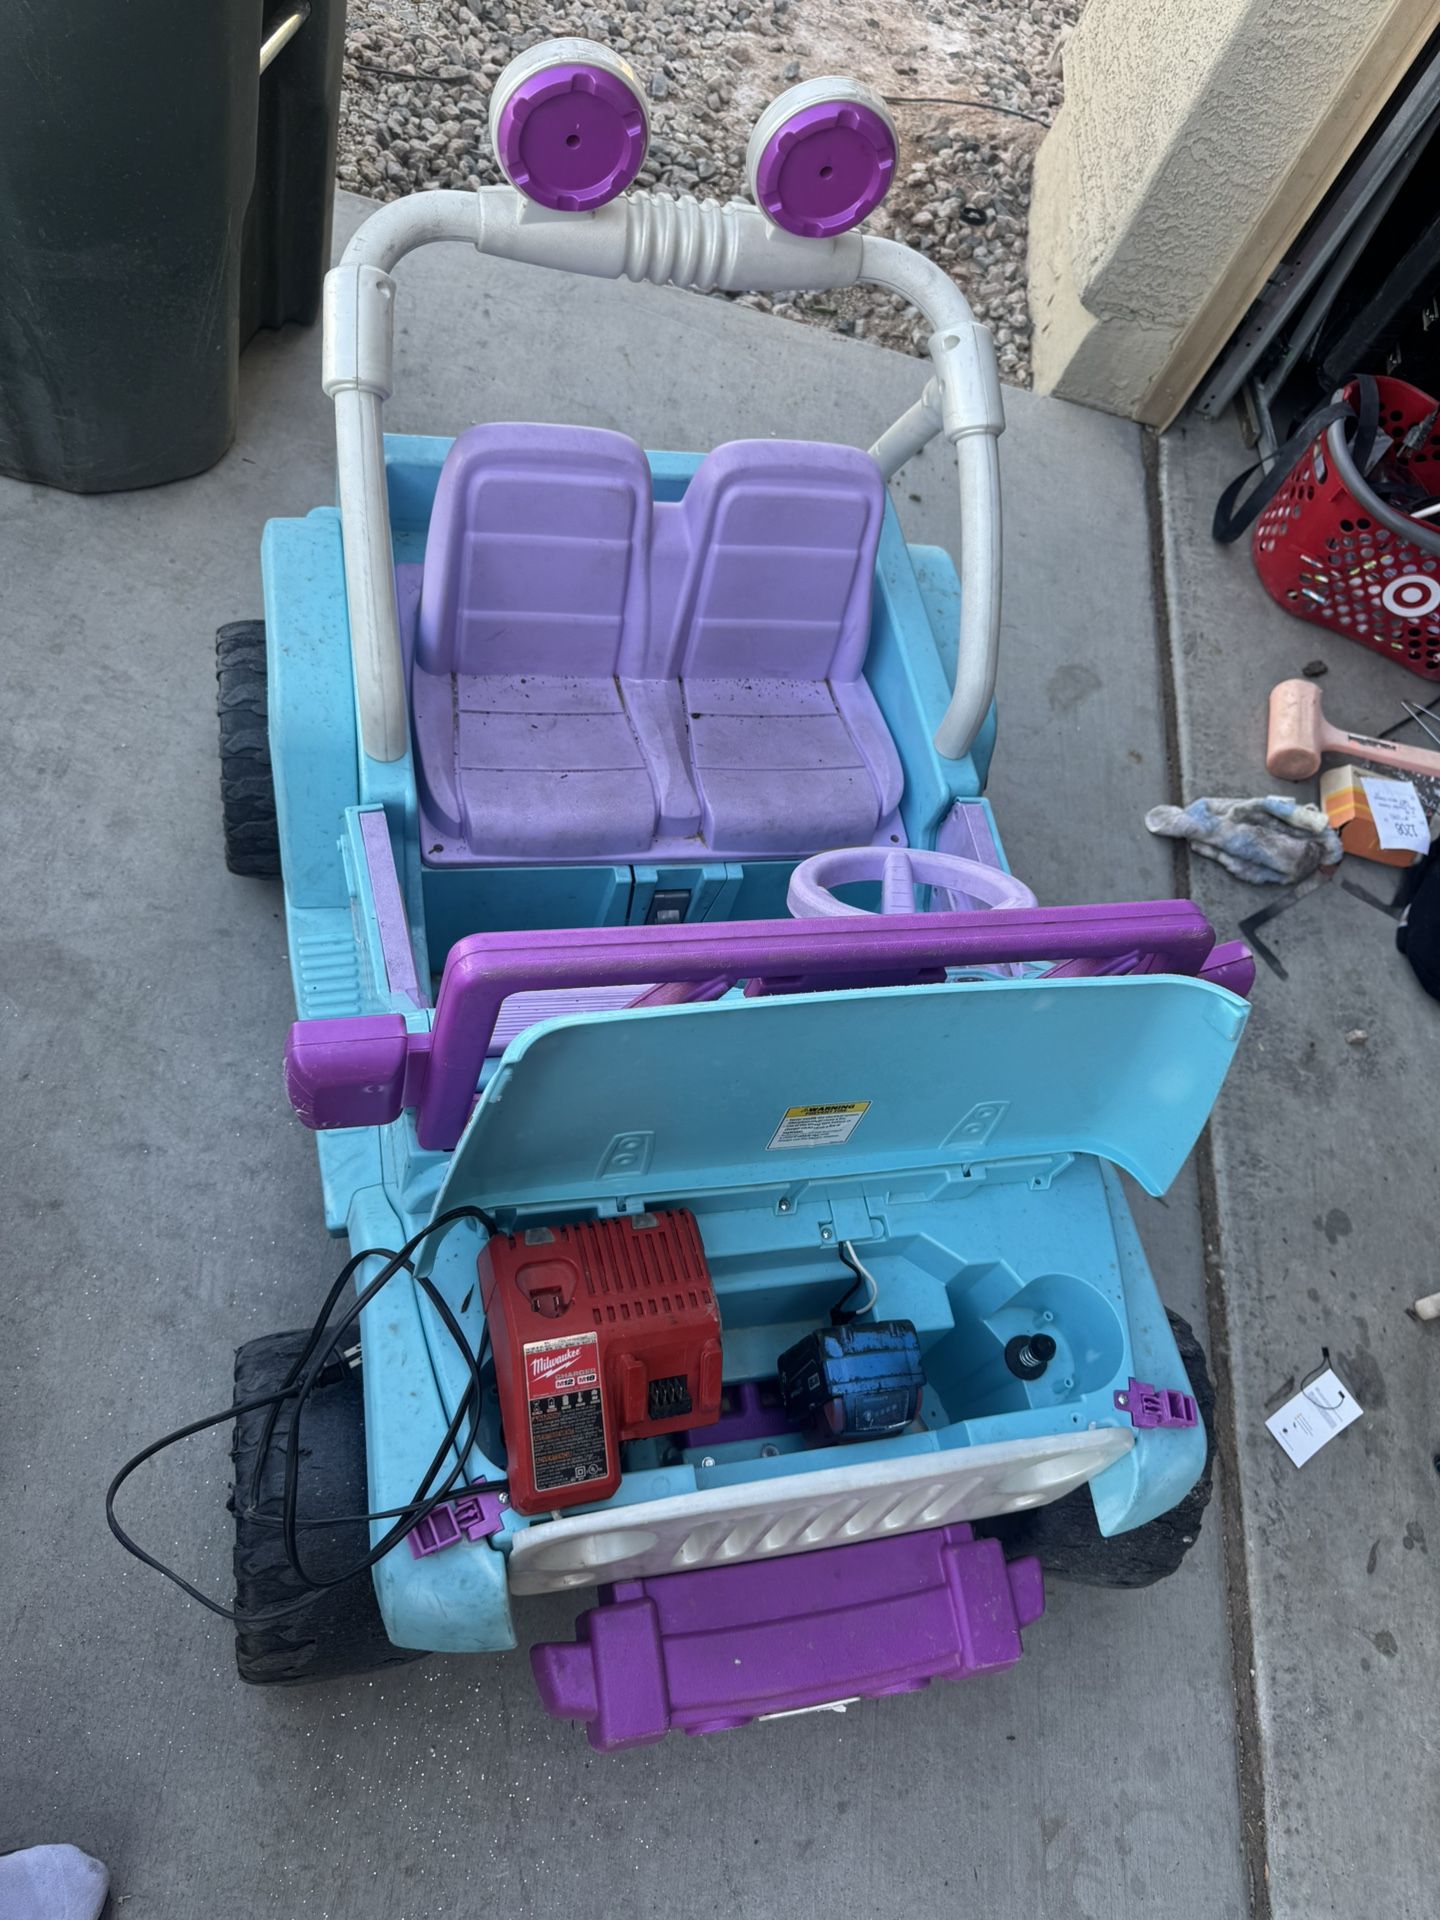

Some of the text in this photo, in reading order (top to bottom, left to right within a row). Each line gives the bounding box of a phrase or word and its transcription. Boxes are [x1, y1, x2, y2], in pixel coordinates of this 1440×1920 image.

[808, 1104, 855, 1112] WARNING
[530, 1347, 581, 1376] Milwaukee
[556, 1374, 595, 1387] M12 M18
